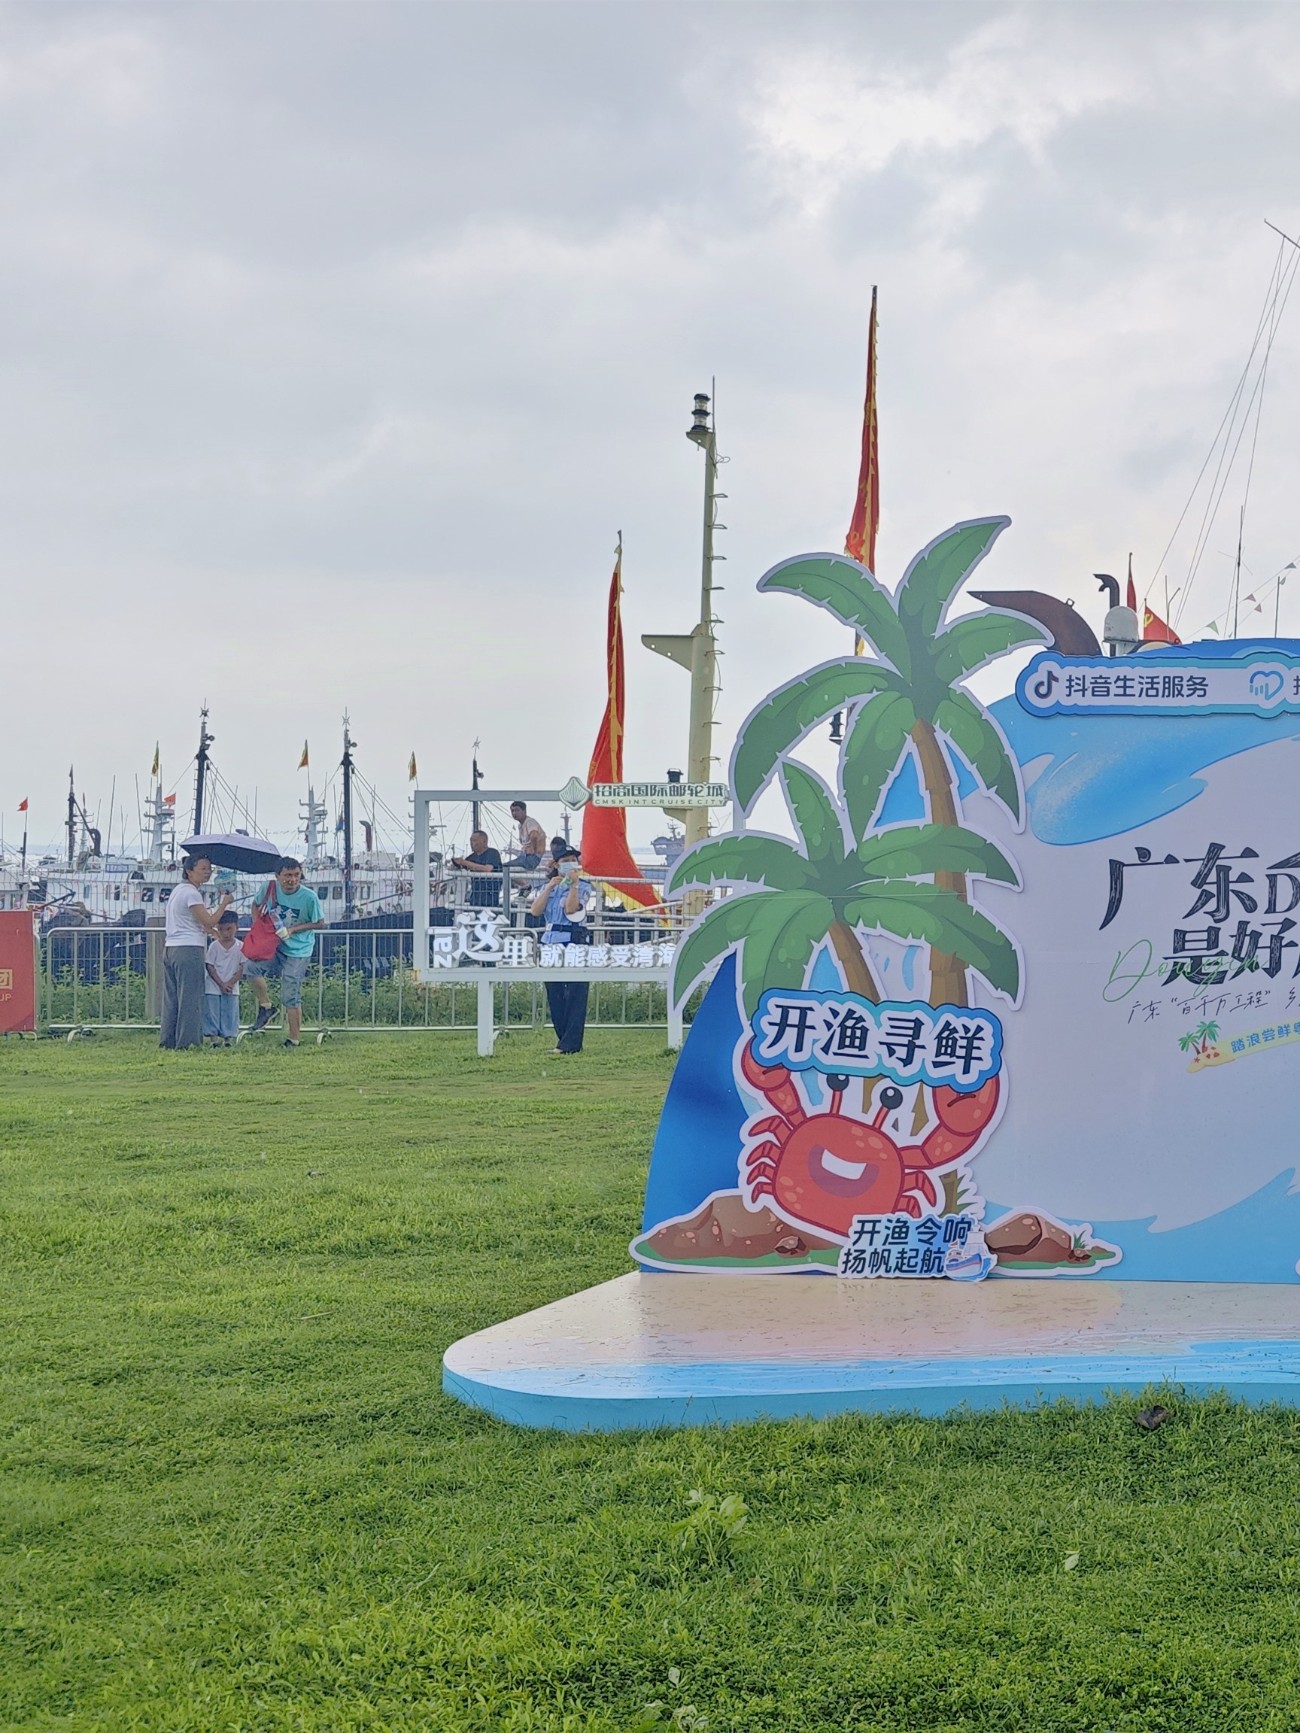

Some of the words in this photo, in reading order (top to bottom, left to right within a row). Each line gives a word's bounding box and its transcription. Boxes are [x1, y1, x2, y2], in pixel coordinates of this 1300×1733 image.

[1065, 674, 1209, 698] 抖音生活服务
[452, 909, 535, 968] 这里
[766, 1003, 985, 1076] 开渔寻鲜
[852, 1217, 972, 1248] 开渔令响
[841, 1247, 945, 1275] 扬帆起航
